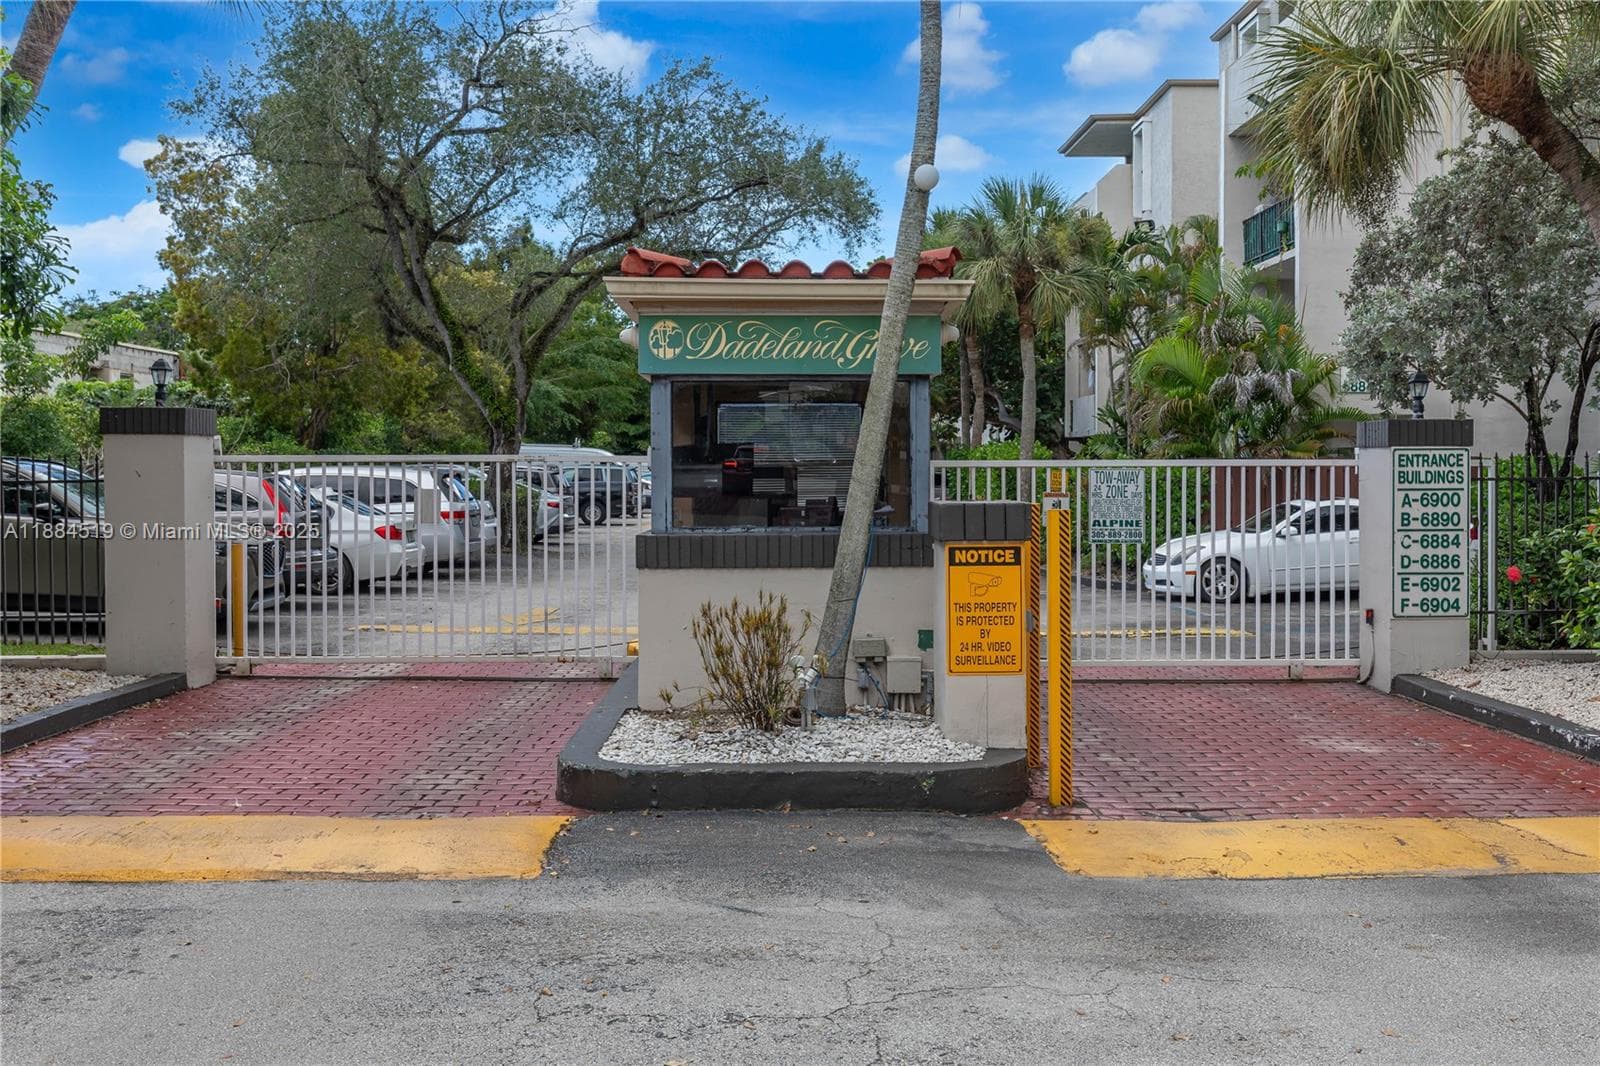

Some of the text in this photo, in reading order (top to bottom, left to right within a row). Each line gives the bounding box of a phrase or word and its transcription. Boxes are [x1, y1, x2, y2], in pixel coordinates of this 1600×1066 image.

[685, 319, 931, 369] Dadeland Grve
[1398, 454, 1464, 467] ENTRANCE
[1094, 470, 1140, 485] TOW-AWAY
[1398, 470, 1464, 484] BUILDINGS
[1106, 485, 1128, 498] ZONE
[1401, 493, 1461, 508] A-6900
[1092, 519, 1142, 527] ALPINE
[1401, 512, 1461, 527] B-6890
[1091, 531, 1142, 539] 305-889-2800
[1401, 534, 1461, 549] C-6884
[955, 550, 1015, 563] NOTICE
[1401, 554, 1461, 569] D-6886
[1401, 577, 1461, 592] E-6902
[954, 602, 1017, 612] THIS PROPERTY
[1401, 598, 1461, 613] F-6904
[956, 616, 1015, 626] IS PROTECTED
[980, 629, 991, 639] BY
[960, 642, 1012, 652] 24 HR. VIDEO
[955, 655, 1017, 665] SURVEILLANCE
